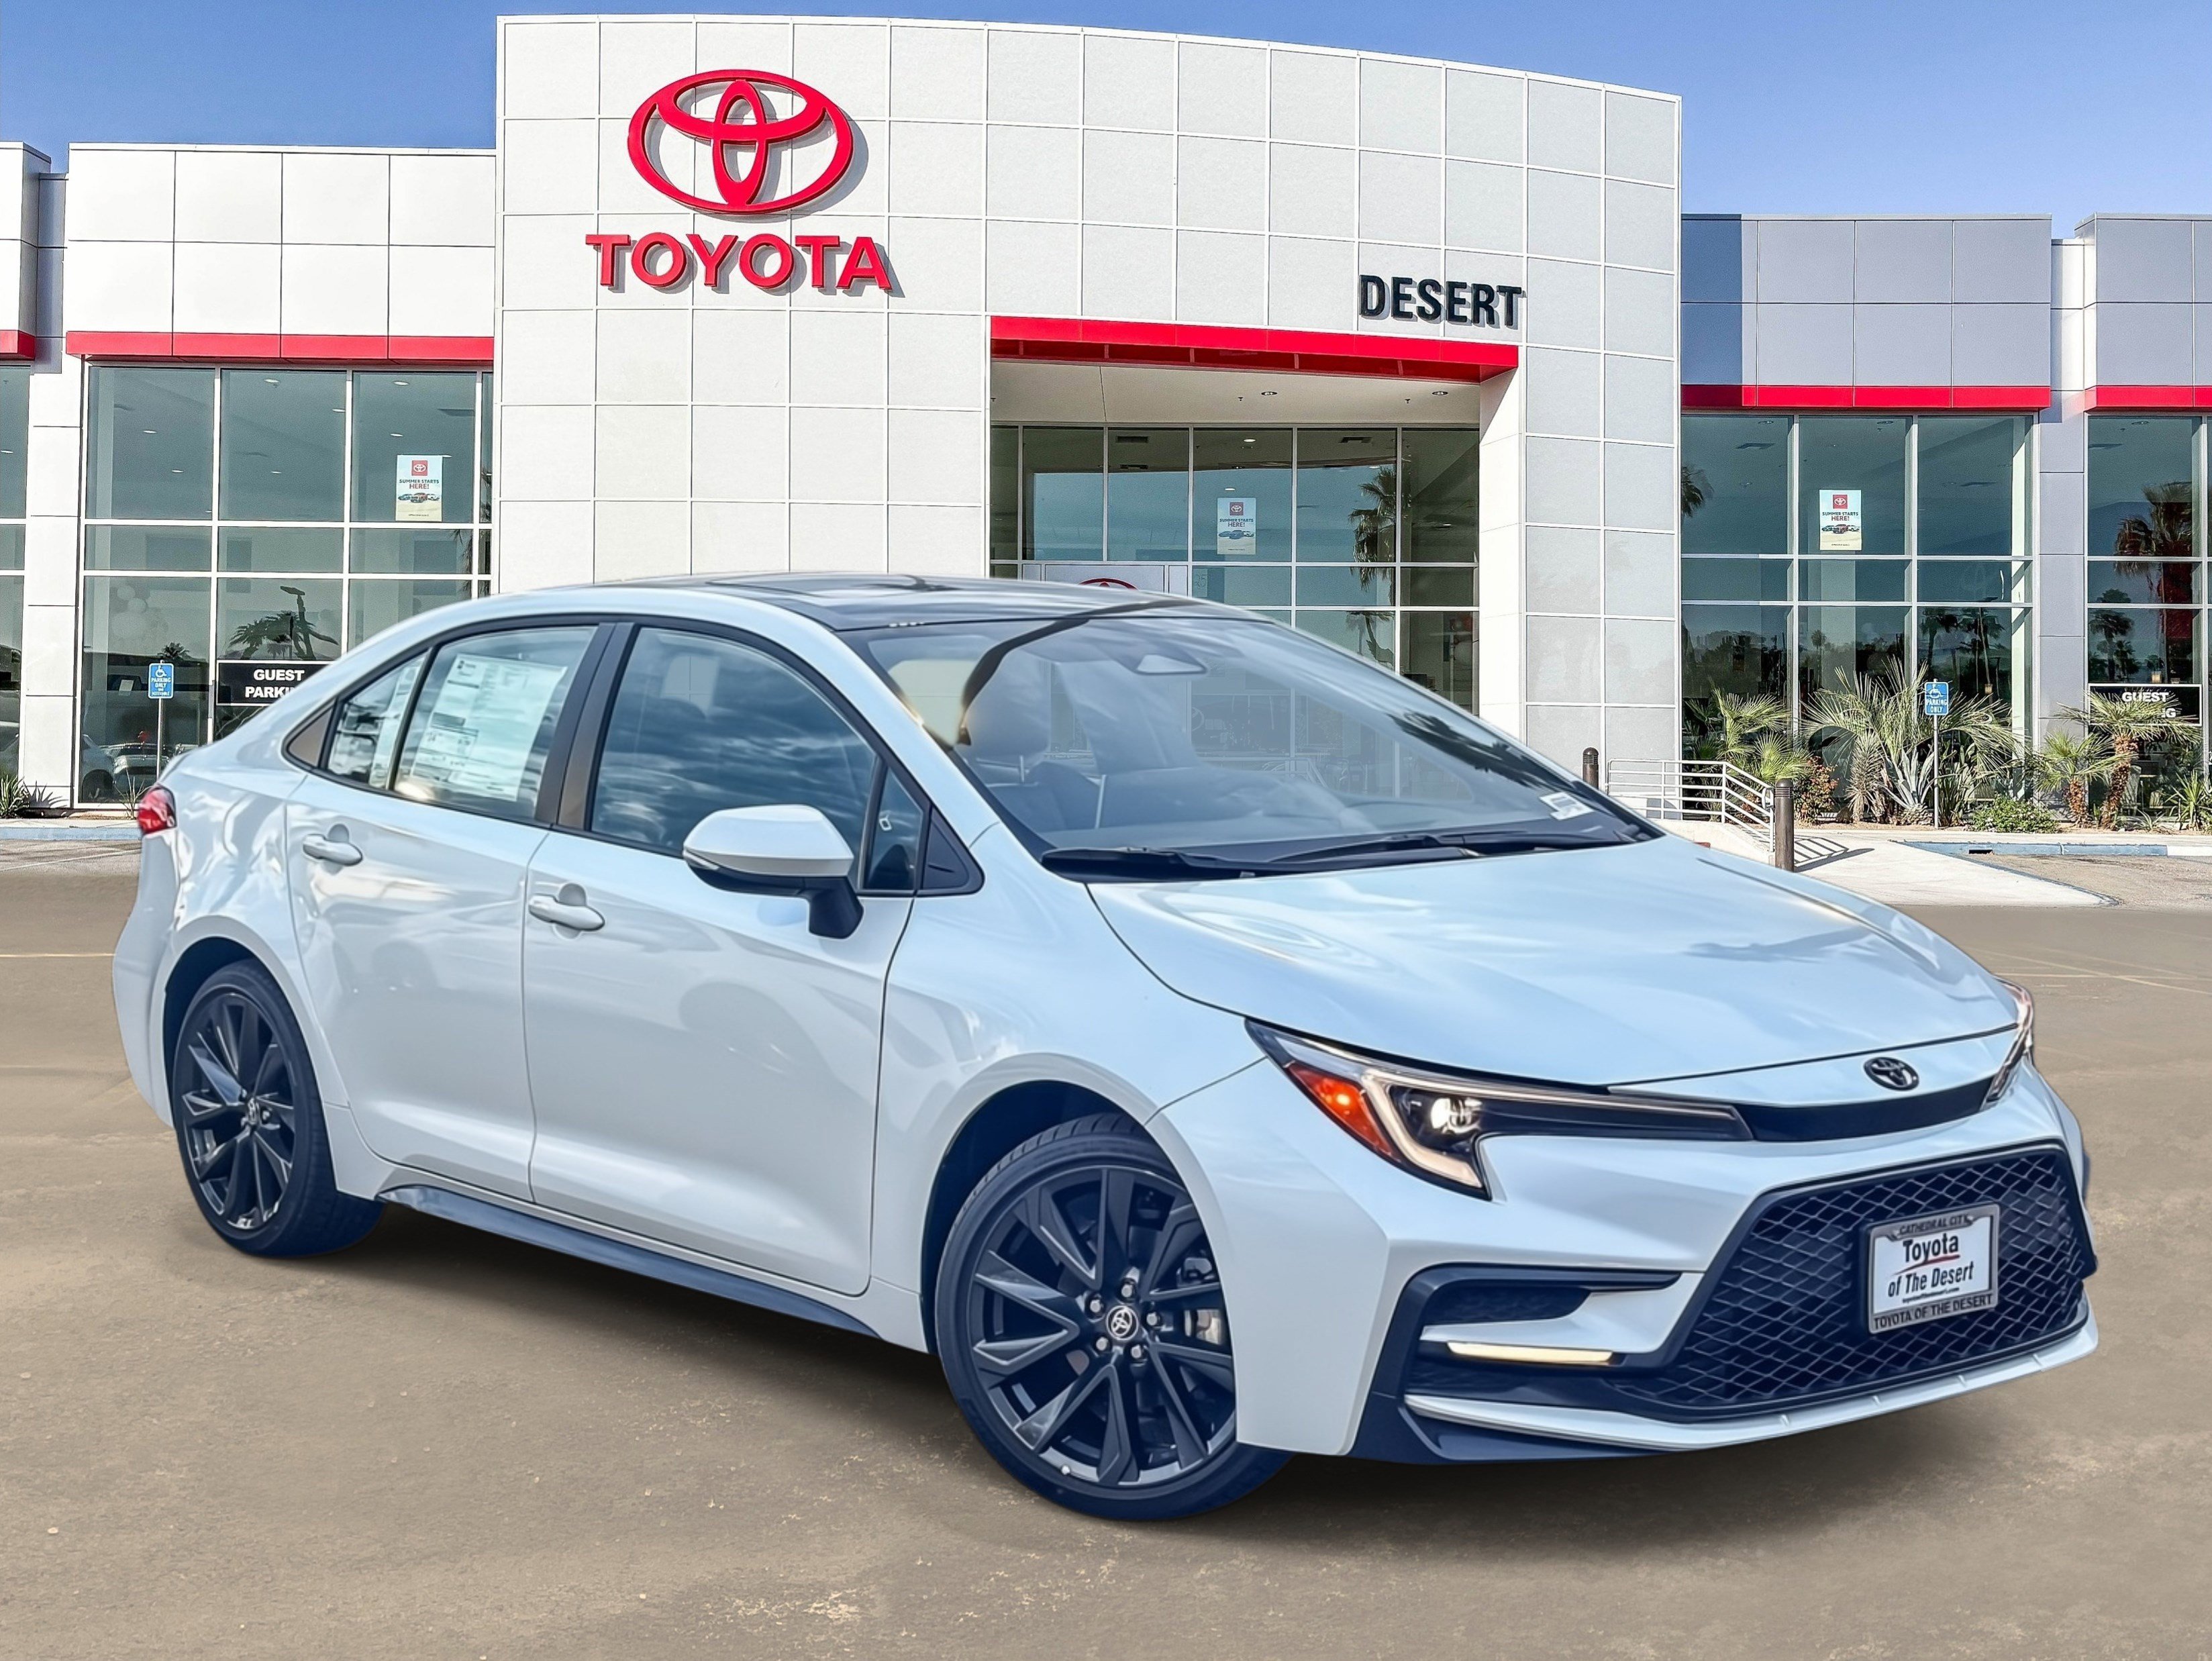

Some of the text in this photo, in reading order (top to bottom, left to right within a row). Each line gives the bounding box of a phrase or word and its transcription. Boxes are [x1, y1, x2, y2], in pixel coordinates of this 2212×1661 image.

[585, 232, 894, 290] TOYOTA
[1359, 274, 1522, 326] DESERT
[253, 669, 305, 681] GUEST
[245, 687, 295, 698] PARKI
[2121, 692, 2169, 703] GUEST
[1930, 705, 1944, 713] ONLY
[1903, 1233, 1959, 1262] Toyota
[1888, 1261, 1974, 1297] of The Desert
[1874, 1293, 1993, 1330] TOYOTA OF THE DESERT
